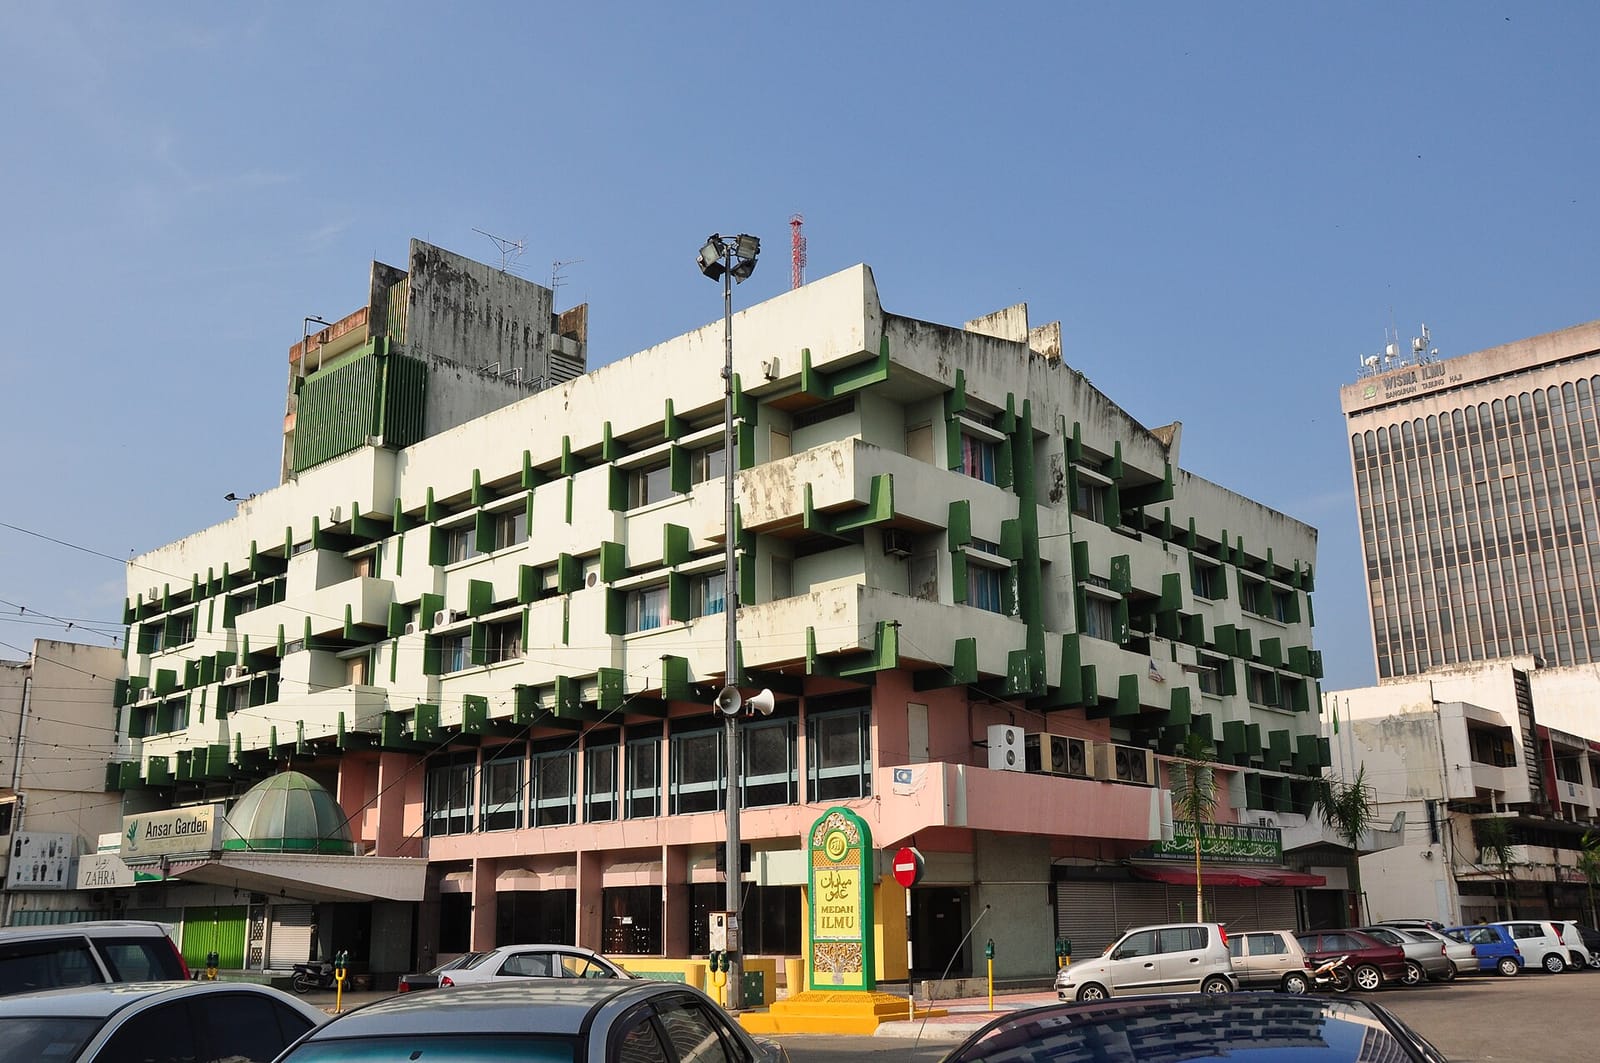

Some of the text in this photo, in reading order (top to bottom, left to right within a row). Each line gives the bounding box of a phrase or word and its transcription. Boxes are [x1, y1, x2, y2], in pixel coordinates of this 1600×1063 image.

[1382, 363, 1446, 391] WISMA ILMU
[145, 816, 208, 838] Ansar Garden
[1204, 824, 1217, 839] NIK
[1219, 825, 1235, 840] ADIB
[1250, 828, 1278, 843] MUSTAFA
[85, 871, 116, 886] ZAHRA
[821, 905, 854, 914] MEDAN
[821, 916, 854, 929] ILMU
